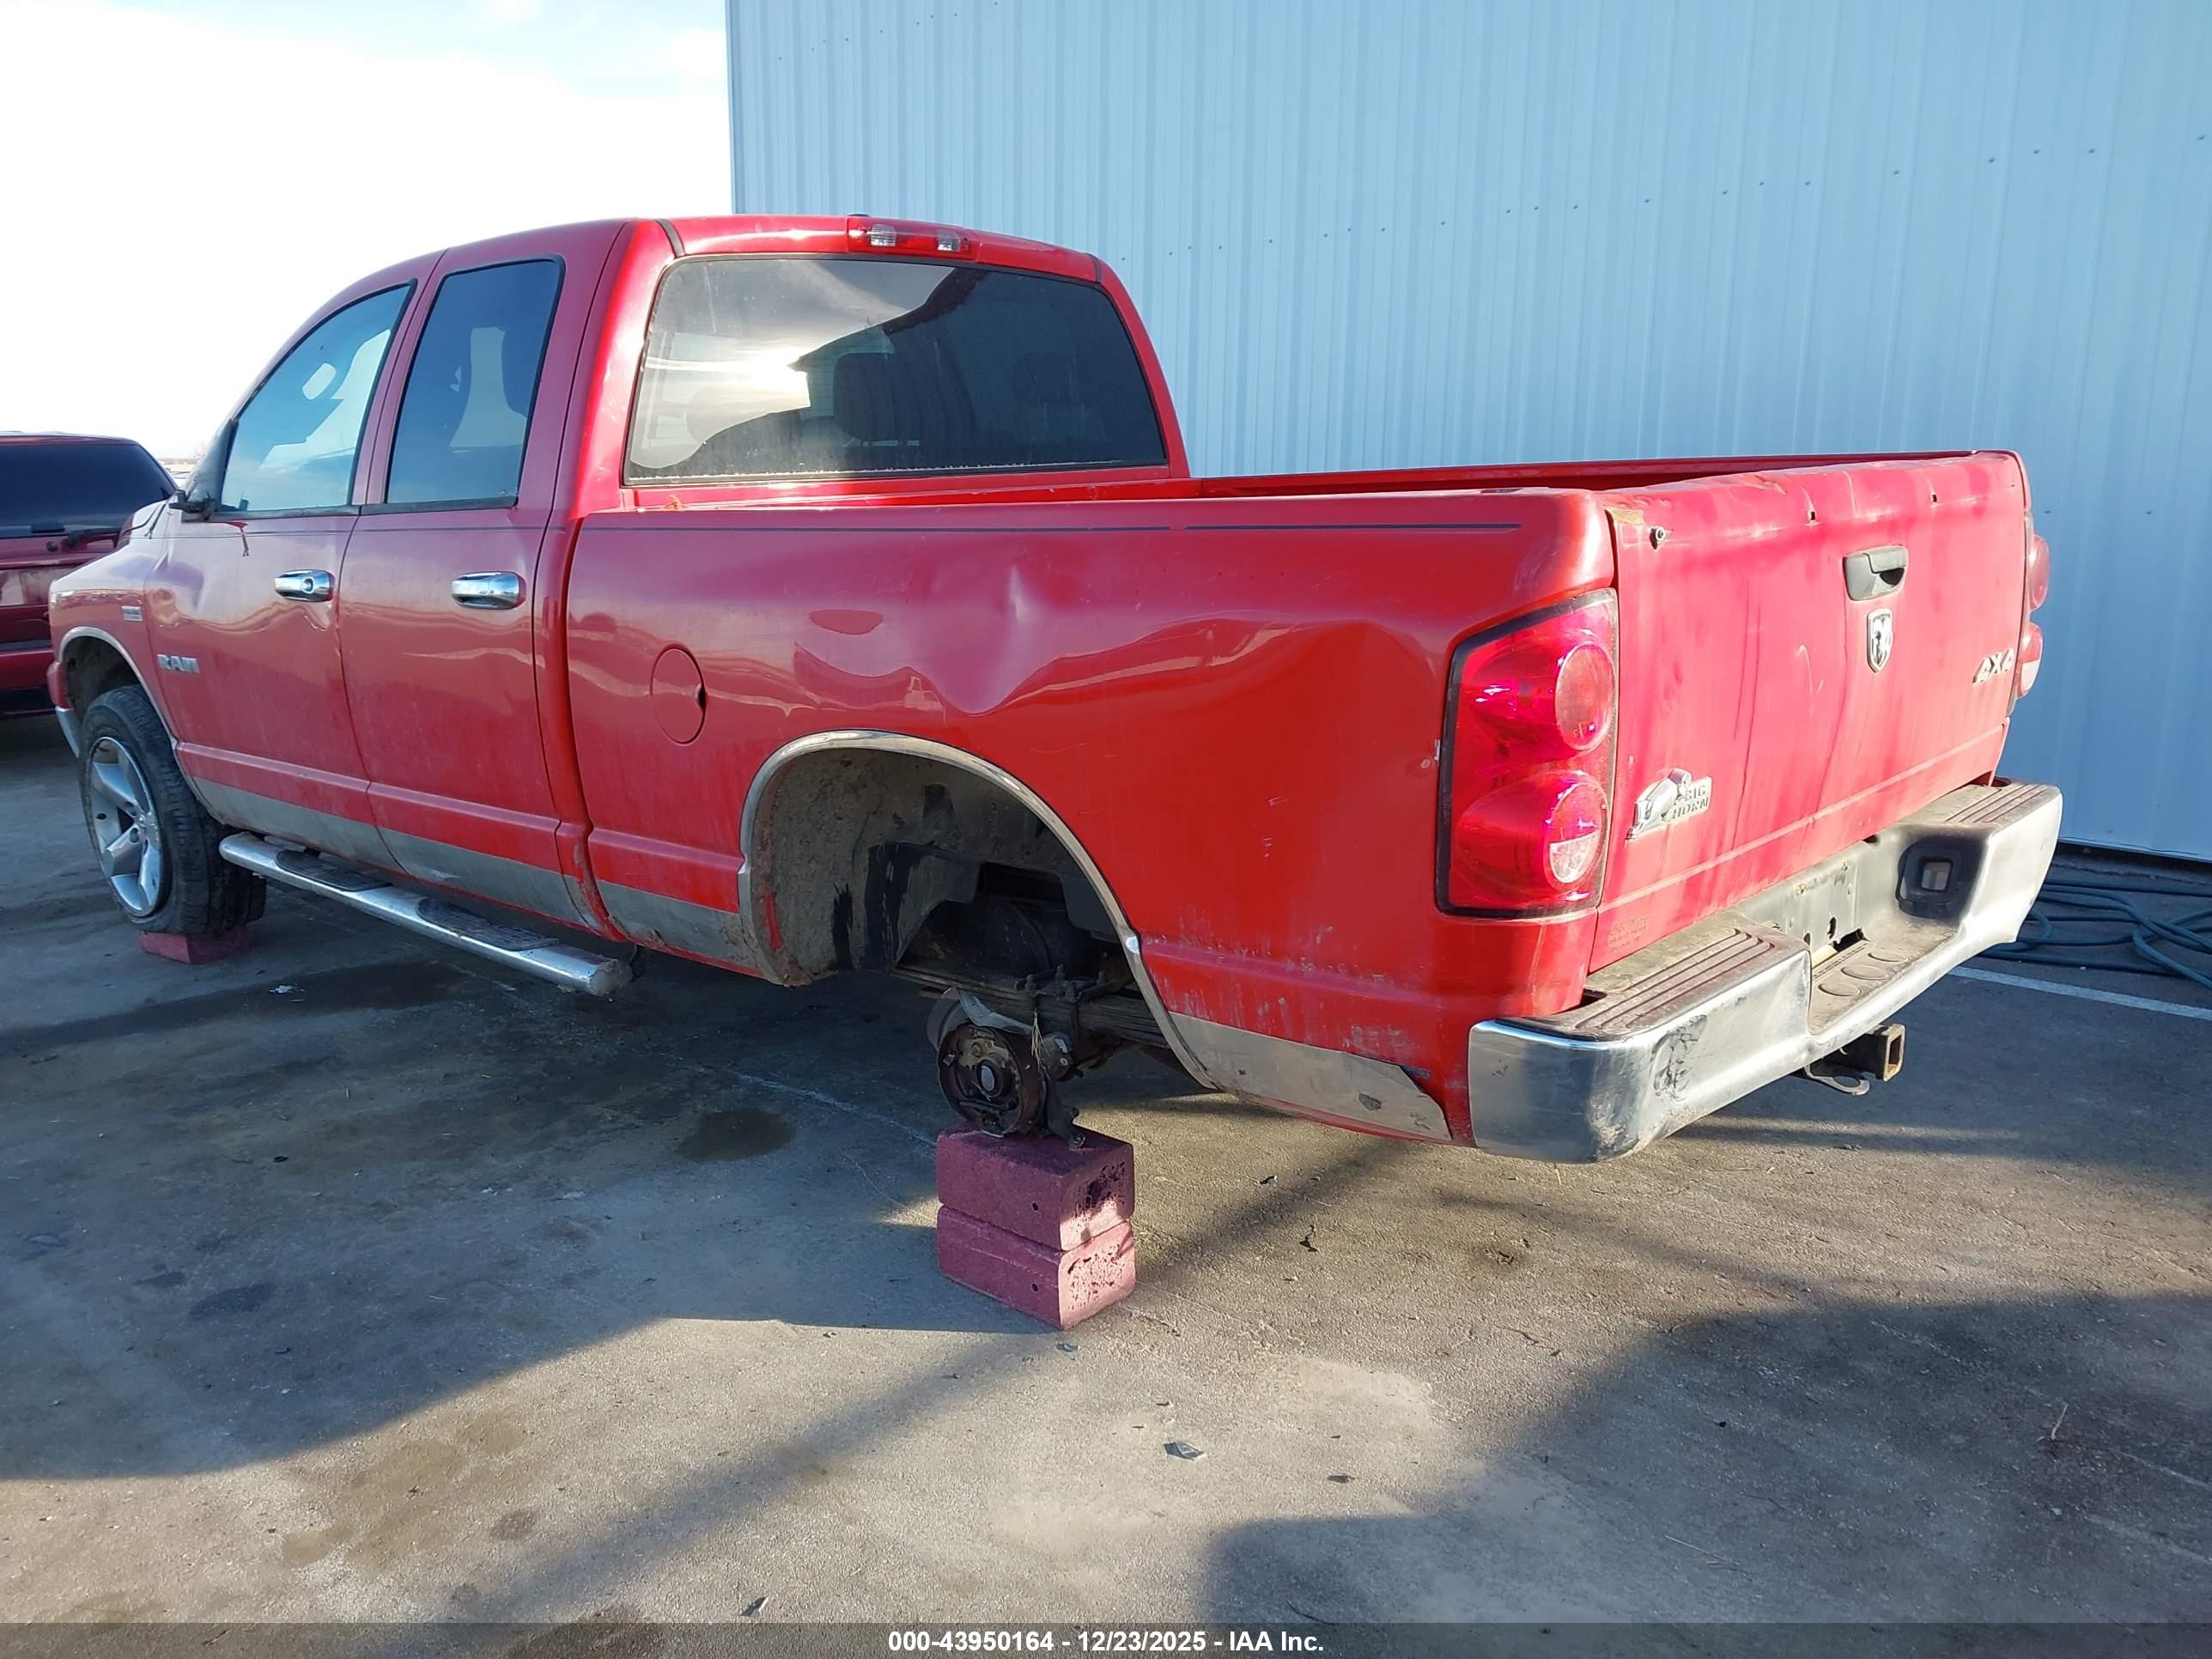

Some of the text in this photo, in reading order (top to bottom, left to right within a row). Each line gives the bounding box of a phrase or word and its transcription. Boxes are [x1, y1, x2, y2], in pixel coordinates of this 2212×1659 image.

[156, 653, 200, 673] RAM
[1686, 784, 1706, 799] BIG
[1672, 796, 1709, 819] HORN
